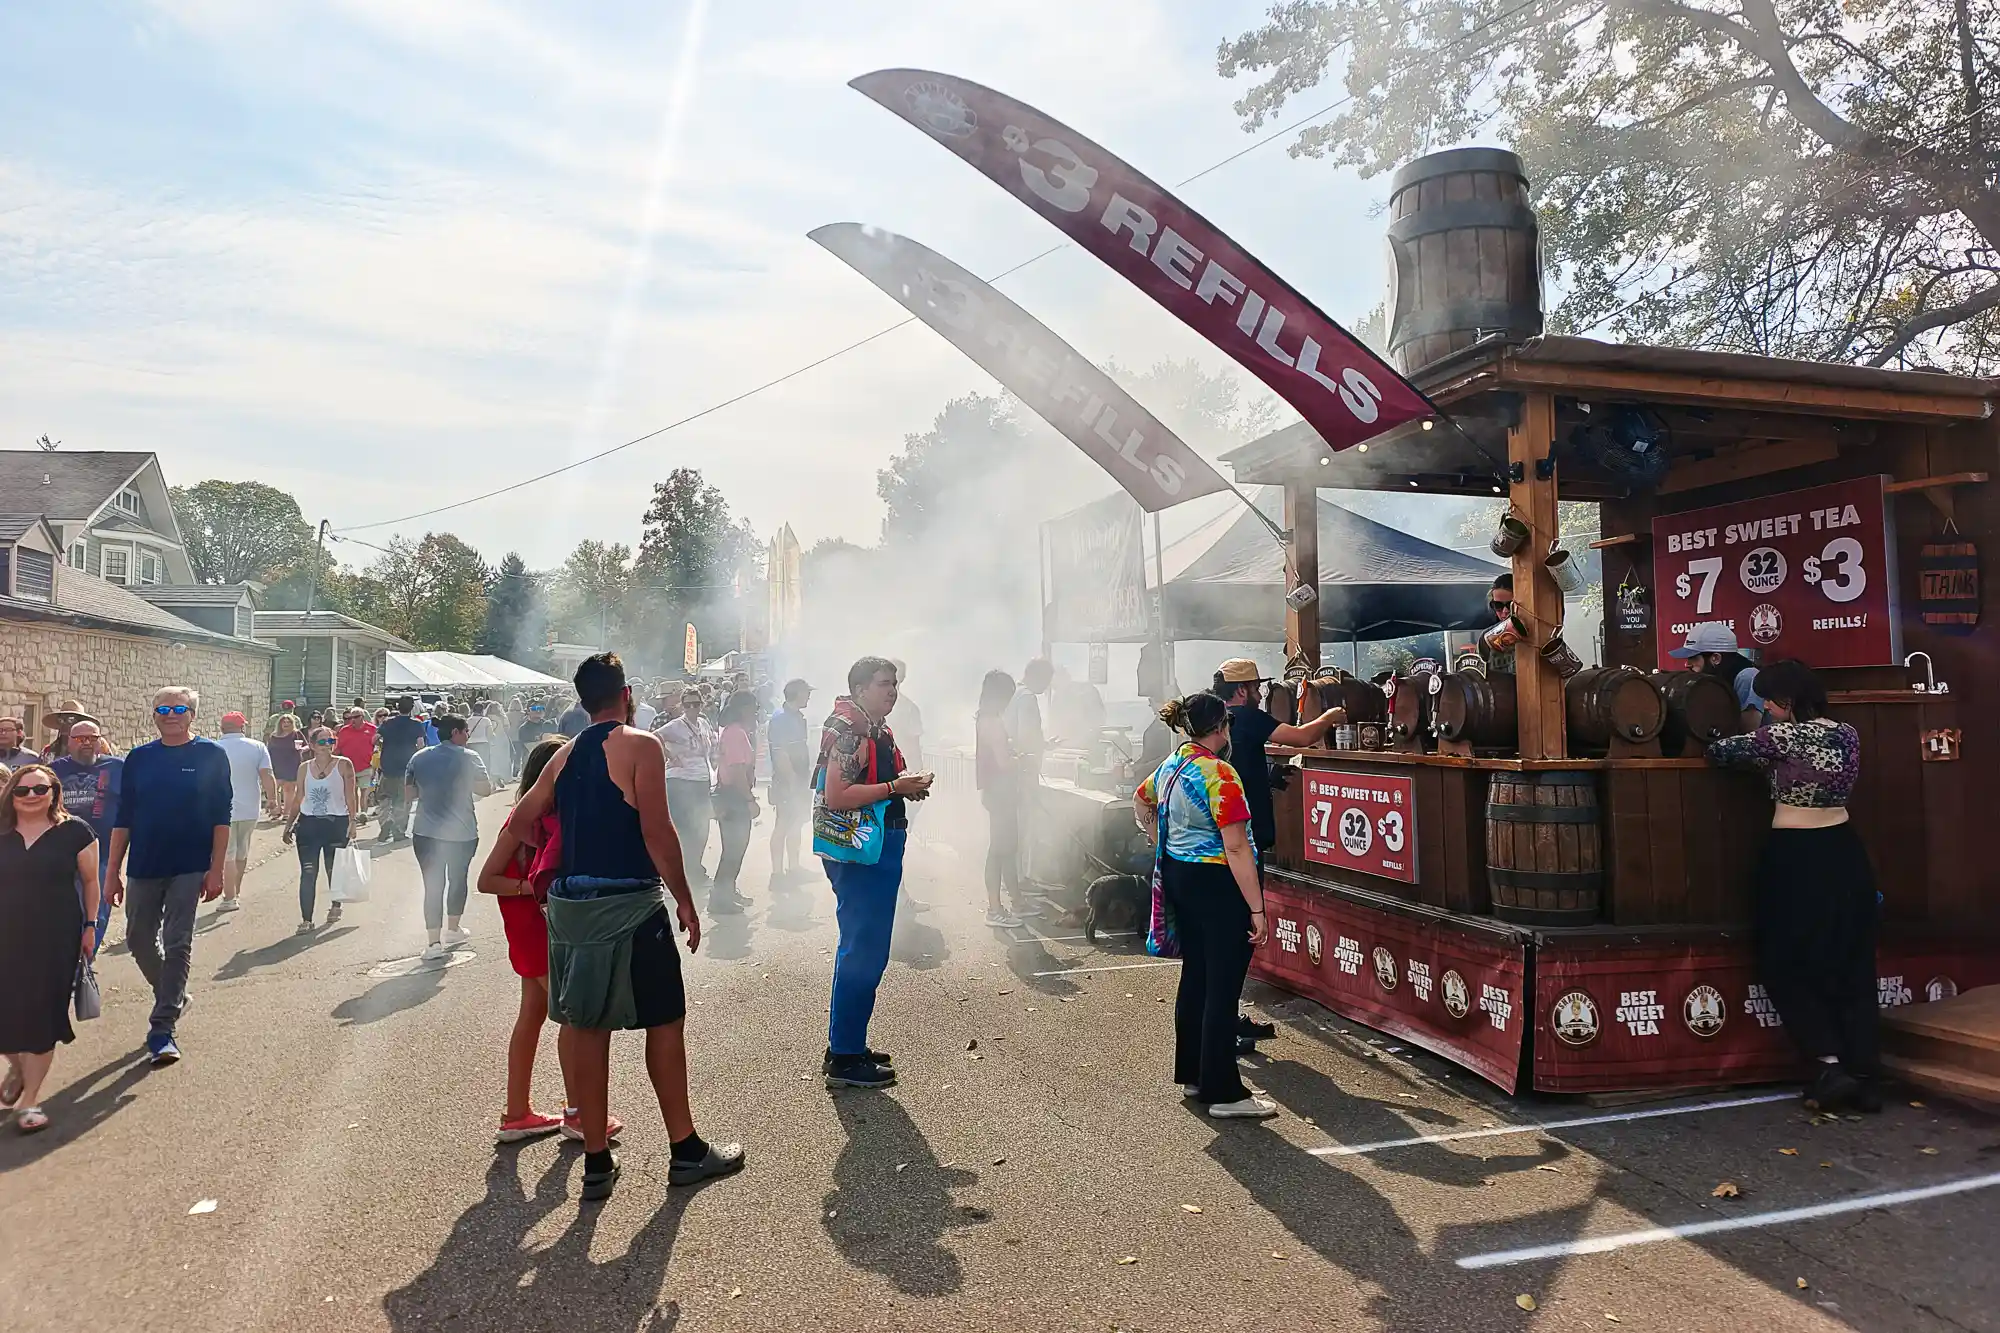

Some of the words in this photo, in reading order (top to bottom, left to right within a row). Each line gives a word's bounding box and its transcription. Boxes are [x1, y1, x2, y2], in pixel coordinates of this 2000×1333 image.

[1001, 123, 1099, 213] $3
[1100, 192, 1383, 424] REFILLS
[985, 320, 1187, 496] REFILLS
[1668, 528, 1717, 553] BEST
[1725, 513, 1802, 545] SWEET
[1809, 504, 1861, 531] TEA
[1747, 551, 1779, 576] 32
[1803, 537, 1867, 602] $3
[1676, 556, 1723, 614] $7
[1747, 575, 1780, 588] OUNCE
[1813, 613, 1867, 630] REFILLS!
[1319, 783, 1339, 797] BEST
[1341, 787, 1370, 801] SWEET
[1372, 791, 1390, 804] TEA
[1311, 801, 1332, 838] $7
[1345, 812, 1367, 838] 32
[1377, 810, 1404, 852] $3
[1344, 837, 1367, 851] OUNCE
[1278, 917, 1297, 932] BEST
[1276, 927, 1301, 944] SWEET
[1339, 935, 1359, 952] BEST
[1281, 939, 1297, 954] TEA
[1333, 947, 1364, 965] SWEET
[1340, 960, 1357, 976] TEA
[1408, 958, 1429, 976] BEST
[1407, 970, 1433, 992] SWEET
[1414, 984, 1429, 1002] TEA
[1483, 983, 1509, 1003] BEST
[1620, 990, 1657, 1007] BEST
[1480, 996, 1512, 1019] SWEET
[1615, 1004, 1665, 1023] SWEET
[1490, 1012, 1505, 1032] TEA
[1627, 1020, 1660, 1036] TEA
